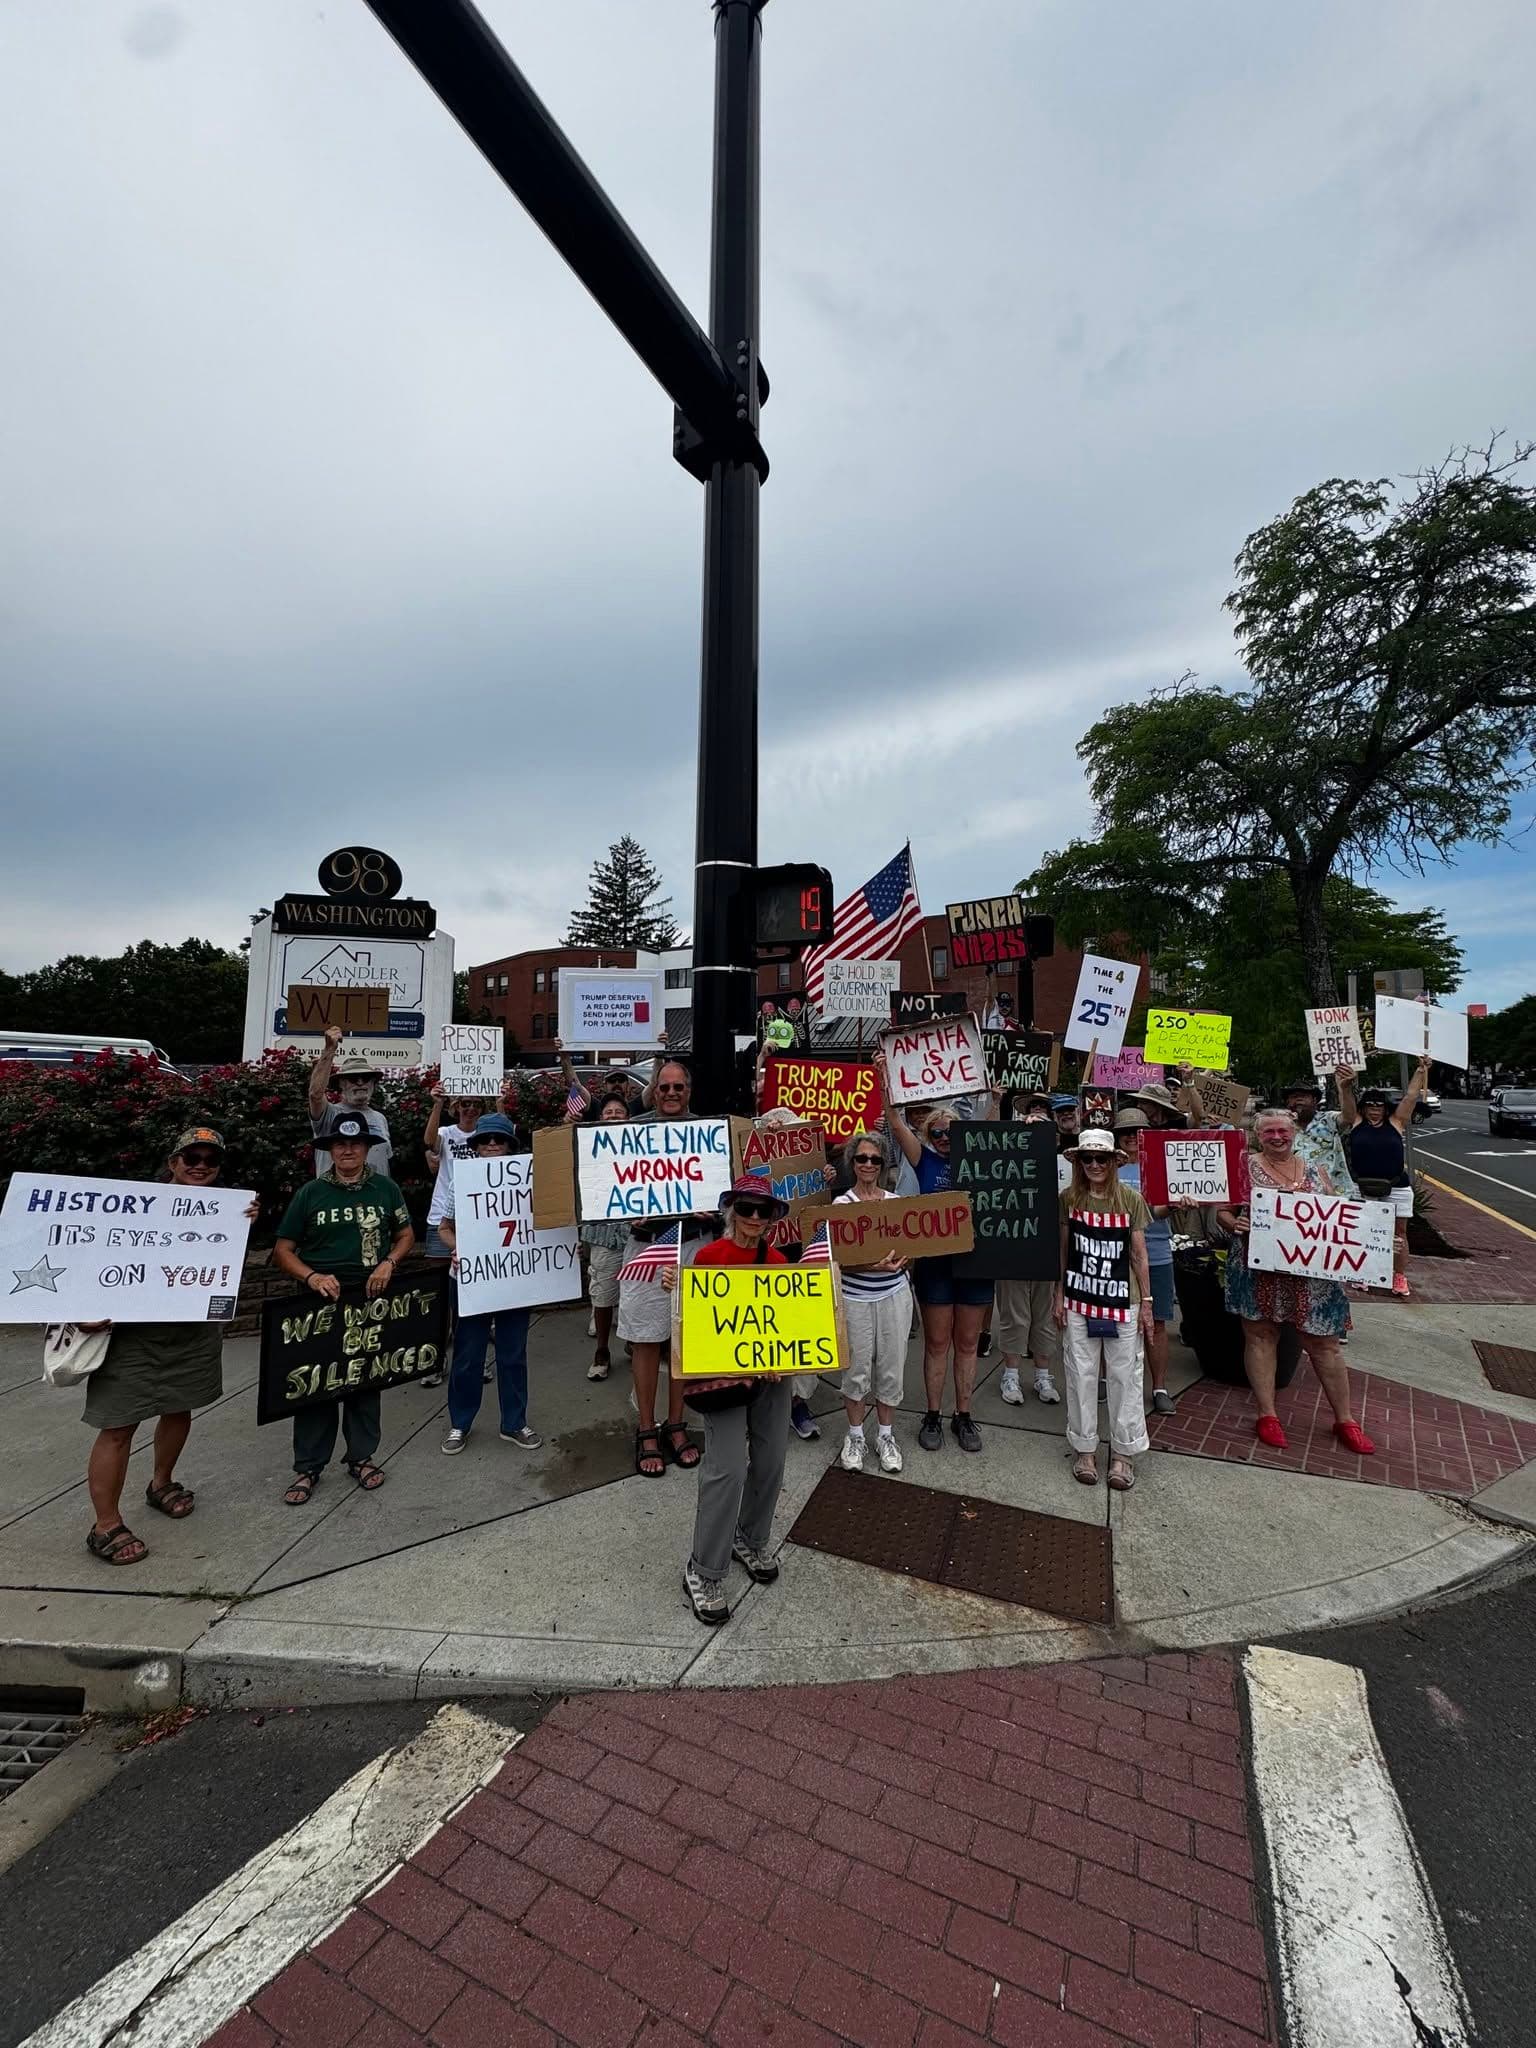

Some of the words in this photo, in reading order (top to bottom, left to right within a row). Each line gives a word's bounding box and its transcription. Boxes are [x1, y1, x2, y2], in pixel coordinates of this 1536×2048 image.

[328, 852, 388, 895] 98
[283, 902, 427, 928] WASHINGTON
[801, 888, 821, 930] 19
[948, 897, 1022, 933] PUNCH
[317, 964, 399, 984] SANDLER
[848, 965, 875, 980] HOLD
[1093, 966, 1113, 978] TIME
[1115, 970, 1124, 983] 4
[829, 981, 894, 996] GOVERNMENT
[1098, 985, 1114, 995] THE
[826, 997, 889, 1012] ACCOUNTABL
[900, 995, 942, 1012] NOT
[1153, 1015, 1187, 1029] 250
[1314, 1008, 1350, 1024] HONK
[441, 1025, 501, 1052] RESIST
[893, 1023, 970, 1058] ANTIFA
[1326, 1026, 1342, 1035] FOR
[350, 1048, 357, 1056] &
[361, 1048, 409, 1059] Company
[1173, 1047, 1194, 1056] NOT
[1318, 1036, 1352, 1052] FREE
[453, 1054, 473, 1064] LIKE
[478, 1054, 496, 1064] IT'S
[923, 1049, 943, 1066] IS
[1118, 1052, 1133, 1065] ME
[1314, 1050, 1360, 1067] SPEECH
[461, 1065, 482, 1075] 1938
[774, 1063, 843, 1089] TRUMP
[856, 1070, 874, 1091] IS
[900, 1054, 978, 1088] LOVE
[1001, 1069, 1044, 1091] ANTIFA
[1129, 1066, 1159, 1078] LOVE
[443, 1077, 500, 1094] GERMANY
[1205, 1081, 1227, 1096] DUE
[777, 1086, 867, 1112] ROBBING
[1197, 1089, 1238, 1110] OCESS
[1210, 1104, 1231, 1119] ALL
[592, 1125, 659, 1159] MAKE
[664, 1125, 727, 1156] LYING
[743, 1127, 824, 1169] ARREST
[965, 1131, 1032, 1152] MAKE
[1166, 1142, 1224, 1158] DEFROST
[613, 1156, 703, 1185] WRONG
[956, 1158, 1037, 1183] ALGAE
[1176, 1158, 1216, 1173] ICE
[1169, 1182, 1192, 1194] OUT
[1194, 1180, 1227, 1194] NOW
[27, 1189, 156, 1214] HISTORY
[171, 1198, 220, 1217] HAS
[467, 1188, 533, 1219] TRUM
[606, 1180, 692, 1218] AGAIN
[971, 1188, 1039, 1212] REAT
[875, 1216, 901, 1238] the
[902, 1206, 969, 1239] COUP
[1275, 1195, 1362, 1229] LOVE
[48, 1224, 96, 1246] ITS
[107, 1228, 172, 1247] EYES
[499, 1219, 535, 1247] 7th
[975, 1216, 1039, 1239] GAIN
[1295, 1222, 1362, 1246] WILL
[1073, 1232, 1124, 1260] TRUMP
[1276, 1239, 1368, 1272] WIN
[100, 1264, 145, 1287] ON
[161, 1265, 230, 1287] YOU!
[459, 1243, 577, 1285] BANKRUPTCY
[1082, 1255, 1097, 1276] IS
[1100, 1260, 1112, 1279] A
[691, 1271, 730, 1299] NO
[754, 1272, 823, 1298] MORE
[1066, 1270, 1129, 1298] TRAITOR
[281, 1304, 336, 1345] WE
[344, 1289, 439, 1328] WON'T
[713, 1305, 780, 1335] WAR
[343, 1324, 385, 1355] BE
[285, 1344, 440, 1400] SILENCED
